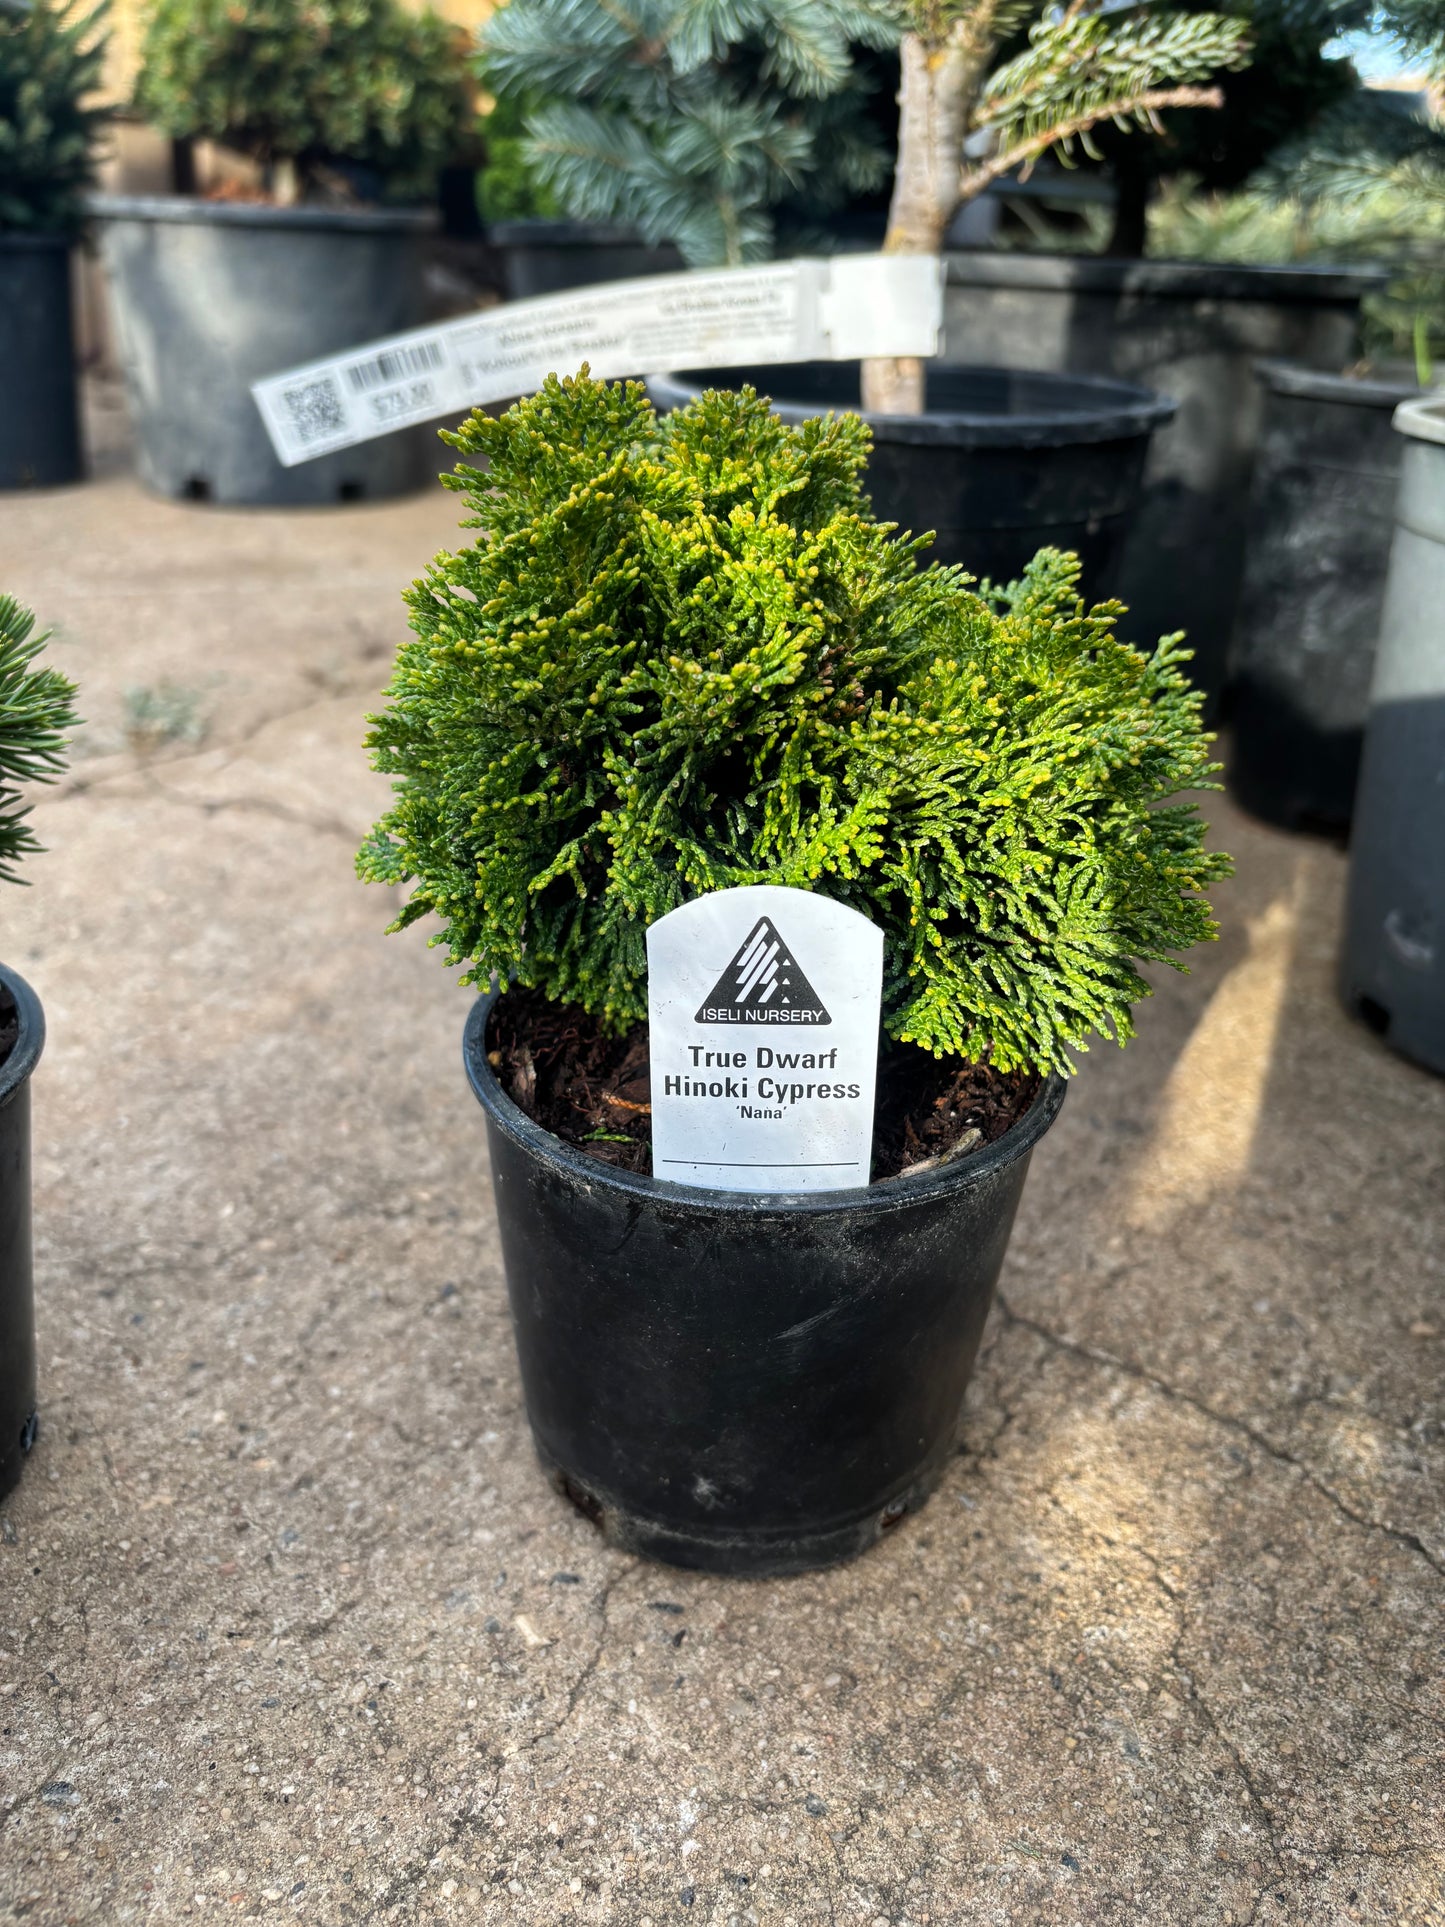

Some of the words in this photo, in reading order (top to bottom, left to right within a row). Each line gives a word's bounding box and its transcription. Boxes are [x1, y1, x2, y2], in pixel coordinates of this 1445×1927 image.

[703, 1008, 740, 1022] ISELI
[745, 1009, 823, 1023] NURSERY
[688, 1046, 747, 1068] True
[756, 1047, 838, 1069] Dwarf
[664, 1075, 748, 1098] Hinoki
[757, 1077, 861, 1104] Cypress
[736, 1105, 788, 1119] 'Nana'
